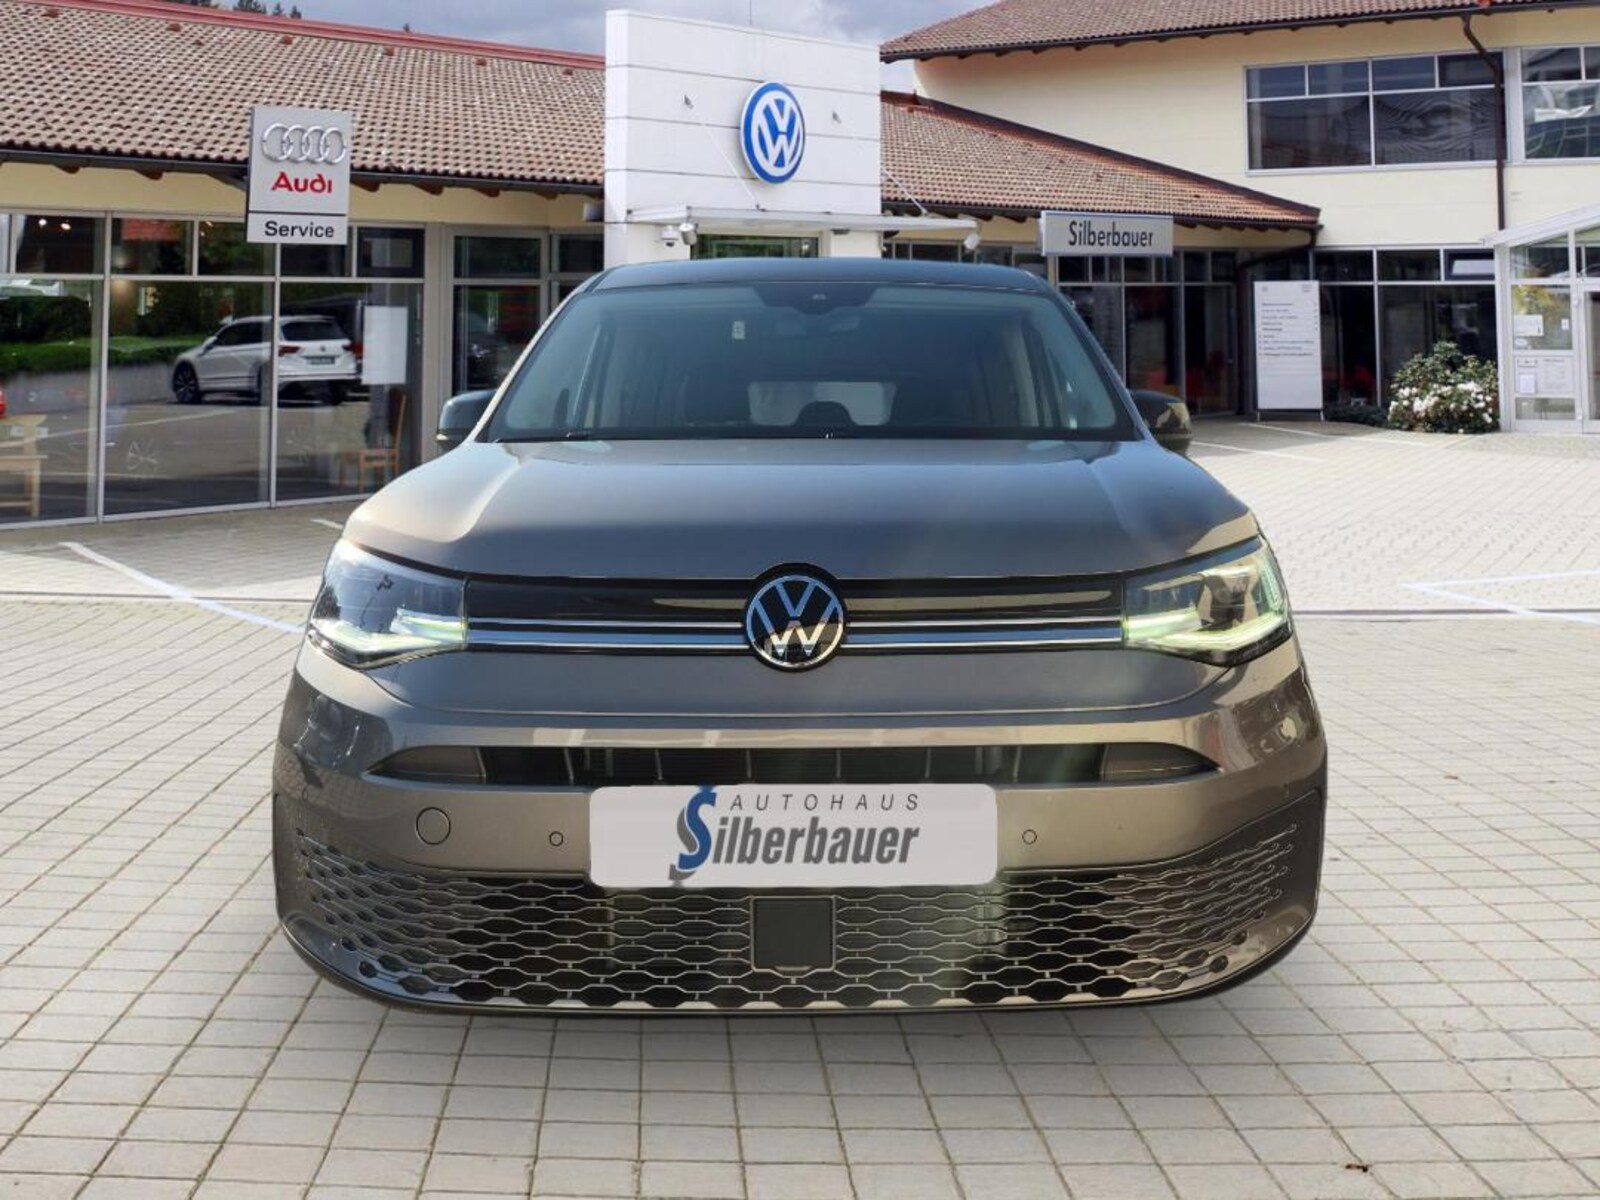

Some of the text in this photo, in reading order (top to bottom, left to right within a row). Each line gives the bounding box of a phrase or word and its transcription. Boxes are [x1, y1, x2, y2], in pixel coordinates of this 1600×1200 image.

[271, 171, 333, 194] Audi
[264, 220, 334, 238] Service
[1068, 220, 1154, 247] Silberbauer
